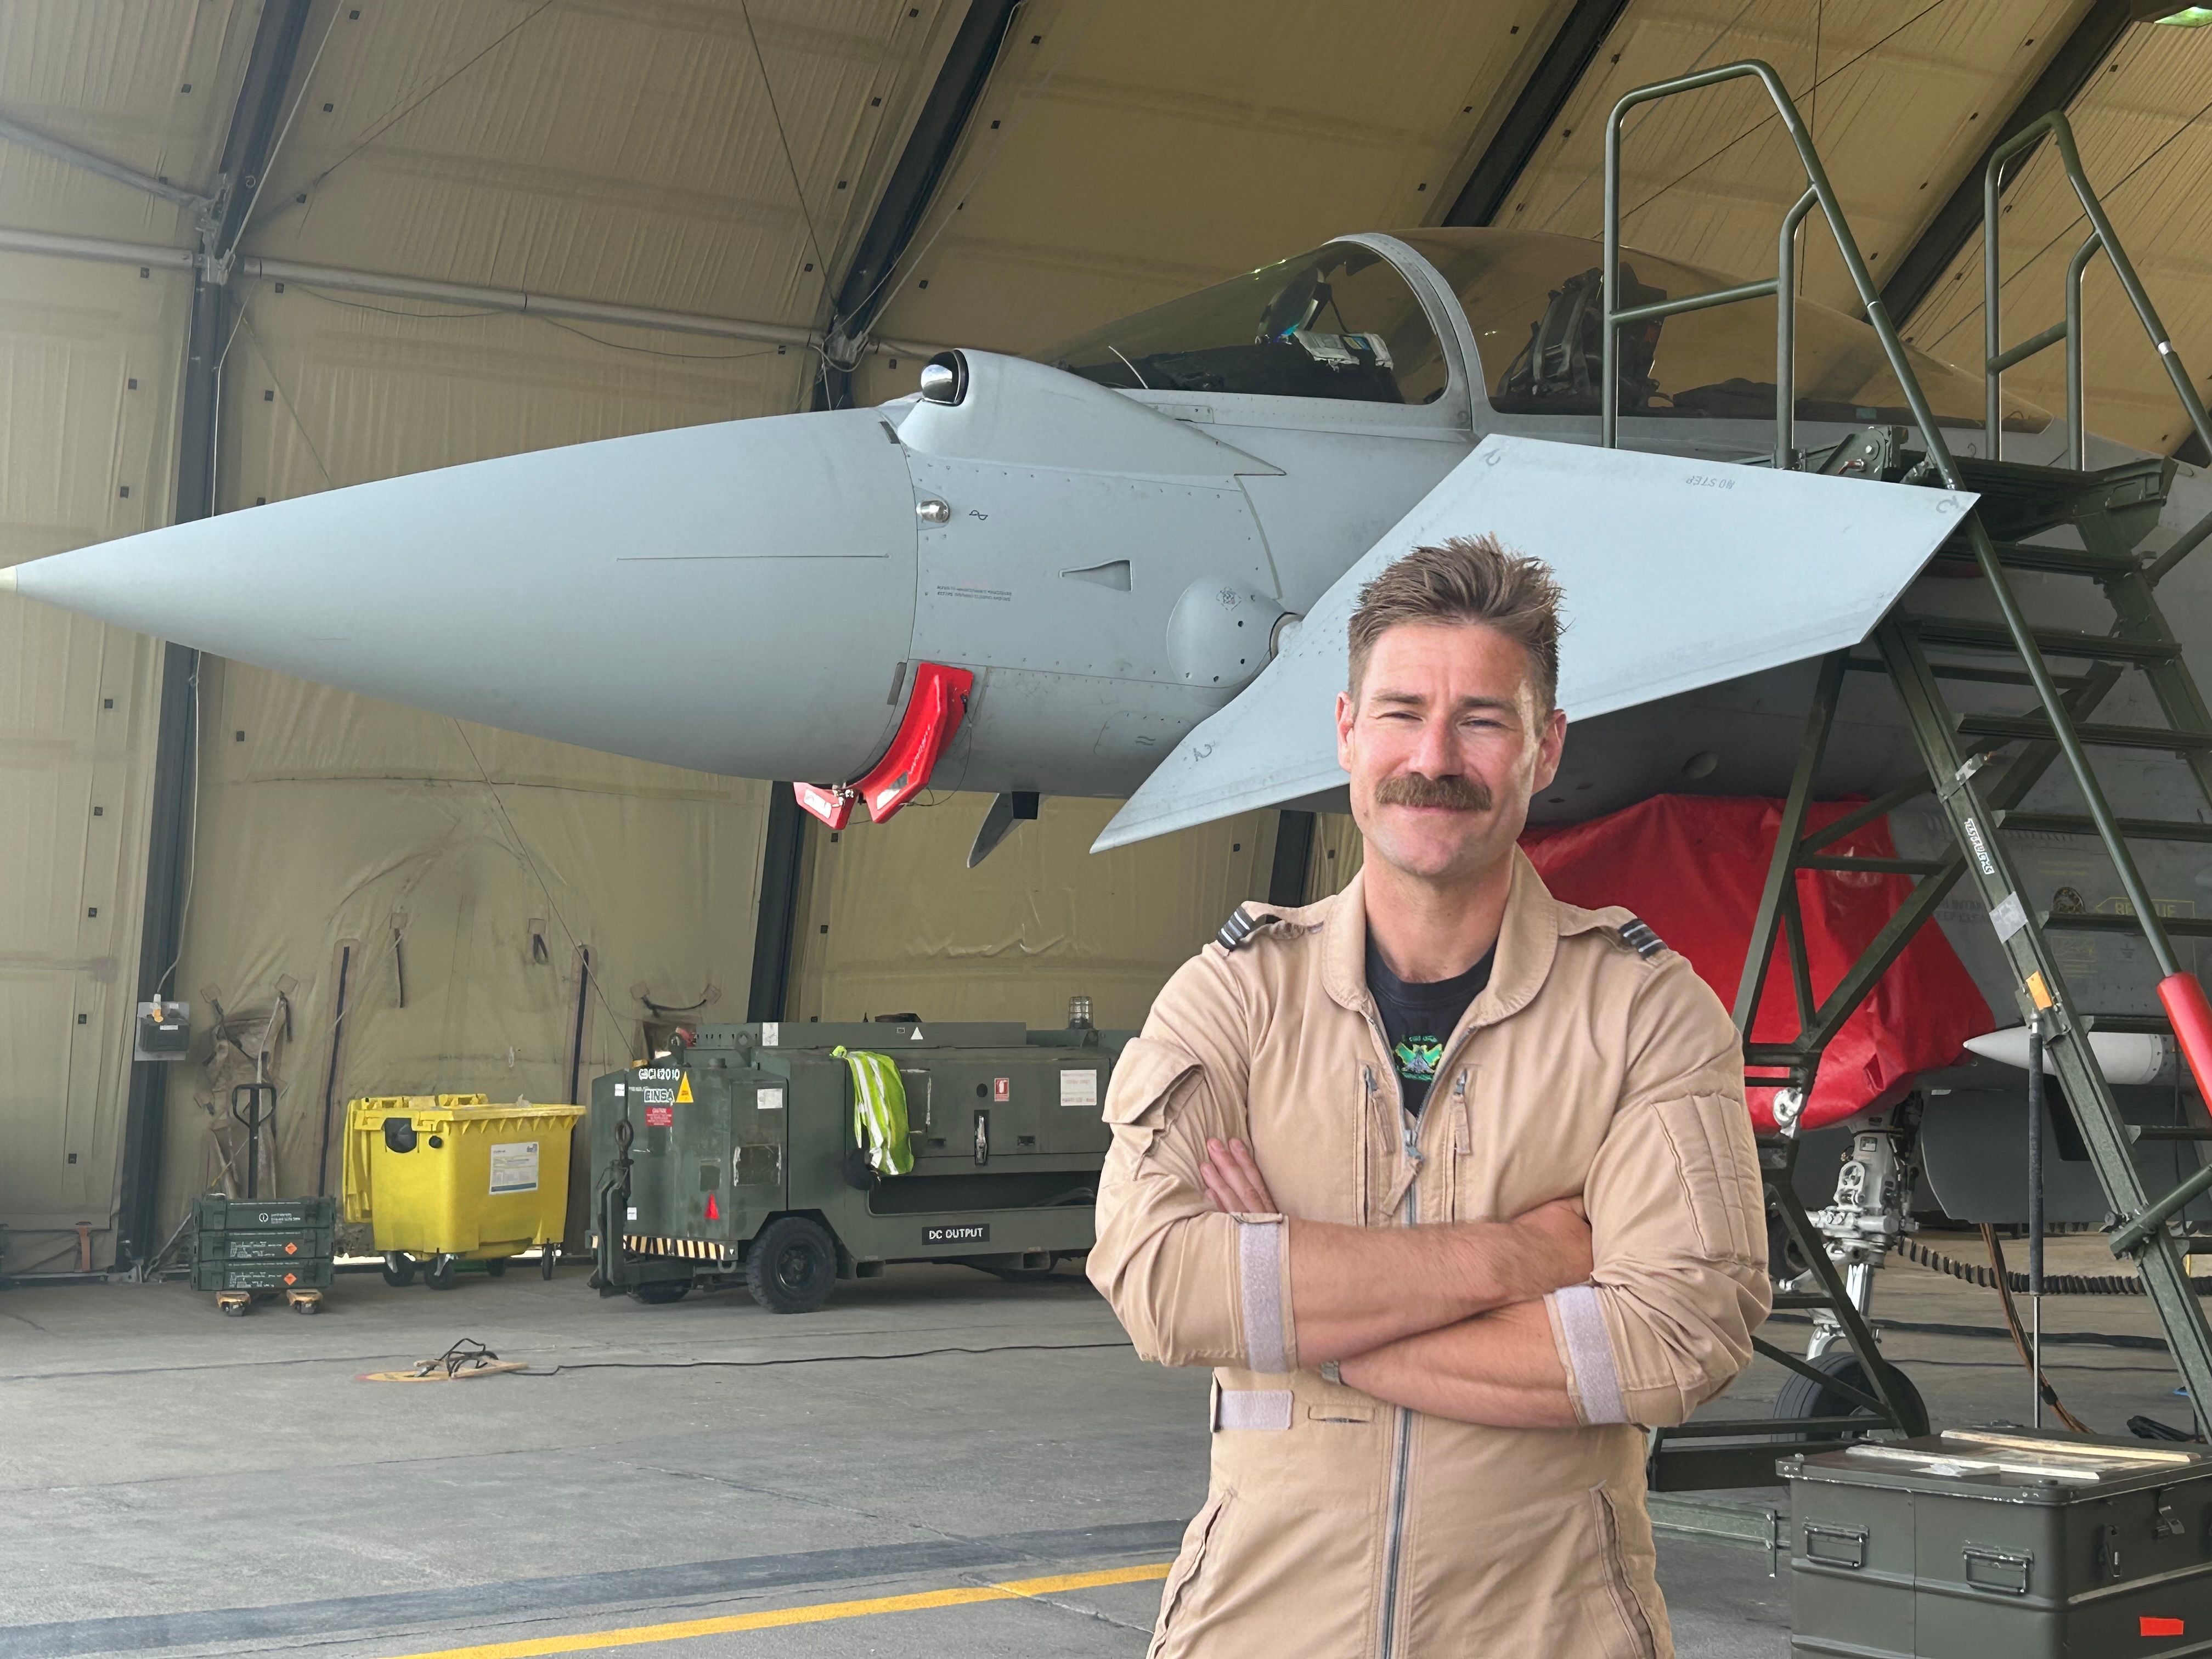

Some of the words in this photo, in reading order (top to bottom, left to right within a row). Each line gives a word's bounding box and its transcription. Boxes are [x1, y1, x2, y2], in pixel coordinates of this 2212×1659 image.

[1686, 475, 1717, 487] STEP
[1718, 478, 1735, 489] NO
[929, 1229, 943, 1239] DC
[945, 1227, 983, 1239] OUTPUT
